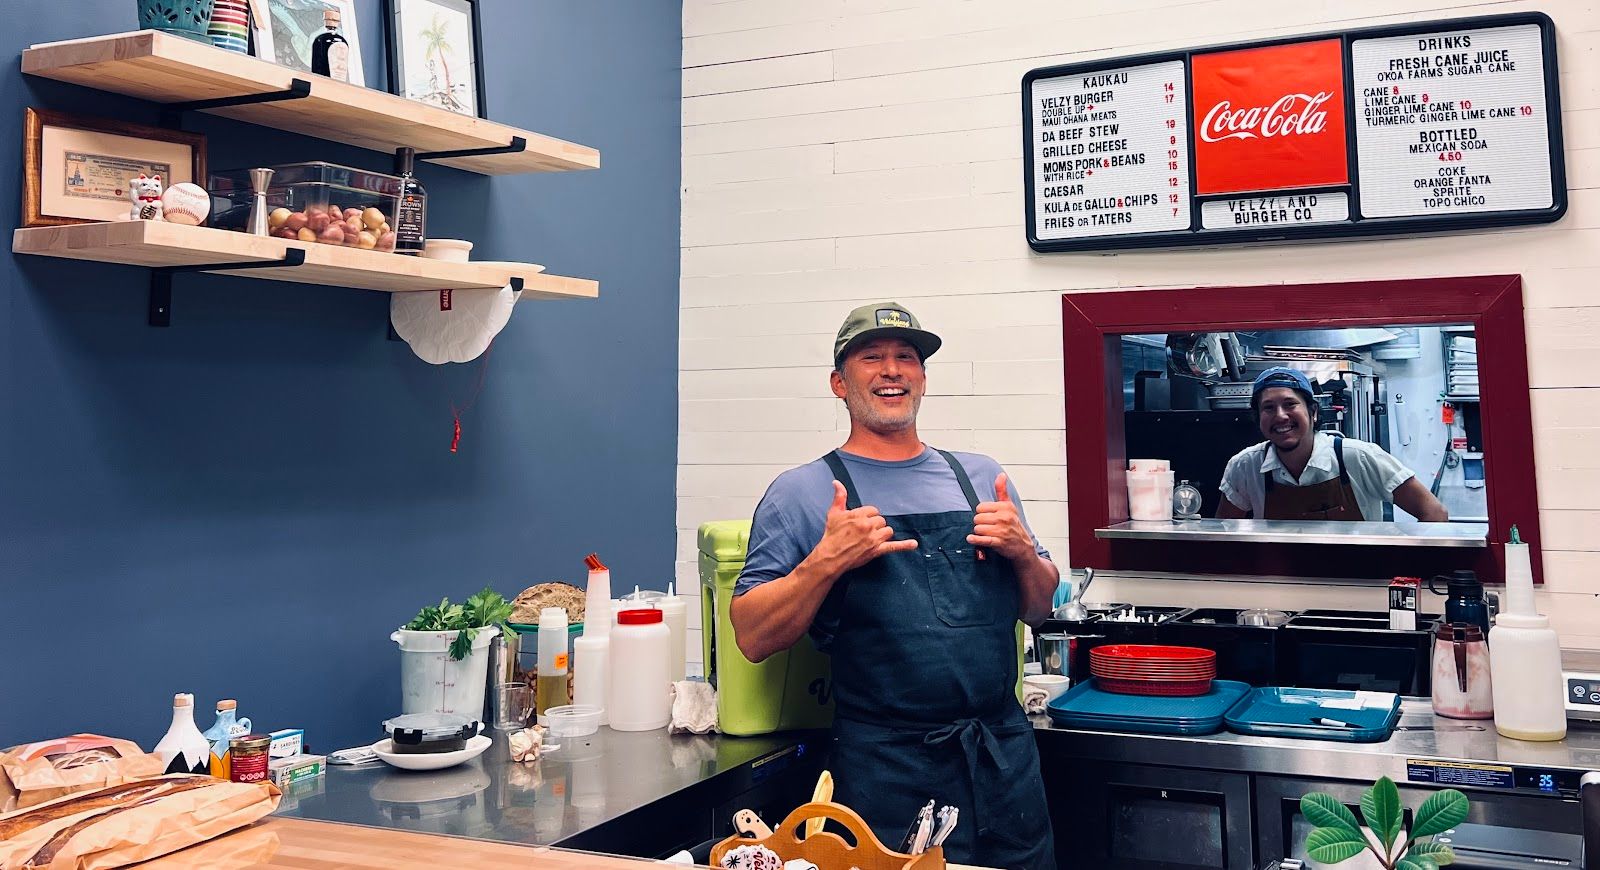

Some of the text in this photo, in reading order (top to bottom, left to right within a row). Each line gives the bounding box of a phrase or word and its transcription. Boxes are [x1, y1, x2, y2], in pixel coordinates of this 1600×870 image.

[1419, 36, 1471, 50] DRINKS
[1390, 50, 1508, 70] FRESH CANE JUICE
[1408, 66, 1443, 78] FARMS
[1447, 65, 1482, 75] SUGAR
[1489, 62, 1515, 73] CANE
[1083, 73, 1128, 88] KAUKAU
[1042, 83, 1173, 109] VELZY BURGER 14
[1364, 86, 1399, 96] CANE 8
[1042, 95, 1174, 117] DOUBLE UP 17
[1365, 94, 1428, 106] LIME CANE 9
[1365, 101, 1471, 116] GINGER LIME CANE 10
[1366, 106, 1531, 126] TURMERIC GINGER LIME CANE 10
[1042, 111, 1117, 126] MAUI OHANA MEATS
[1042, 120, 1175, 142] DA BEEF STEW 19
[1420, 128, 1477, 142] BOTTLED
[1043, 144, 1084, 157] GRILLED
[1089, 139, 1127, 153] CHEESE
[1409, 140, 1487, 153] MEXICAN SODA
[1043, 161, 1073, 173] MOMS
[1076, 158, 1102, 170] PORK
[1168, 150, 1177, 158] 10
[1439, 152, 1462, 161] 4.50
[1044, 162, 1177, 182] WITH RICE 15
[1439, 167, 1466, 176] COKE
[1044, 178, 1178, 198] CAESAR 12
[1414, 176, 1491, 188] ORANGE FANTA
[1433, 187, 1471, 197] SPRITE
[1045, 202, 1070, 213] KULA
[1072, 203, 1082, 211] DE
[1085, 198, 1116, 209] GALLO
[1169, 195, 1178, 203] 12
[1228, 196, 1317, 212] VELZYLAND
[1423, 196, 1485, 207] TOPO CHICO
[1045, 208, 1178, 229] FRIES OR TATERS 7
[1235, 210, 1287, 224] BURGER
[1539, 774, 1553, 787] 35
